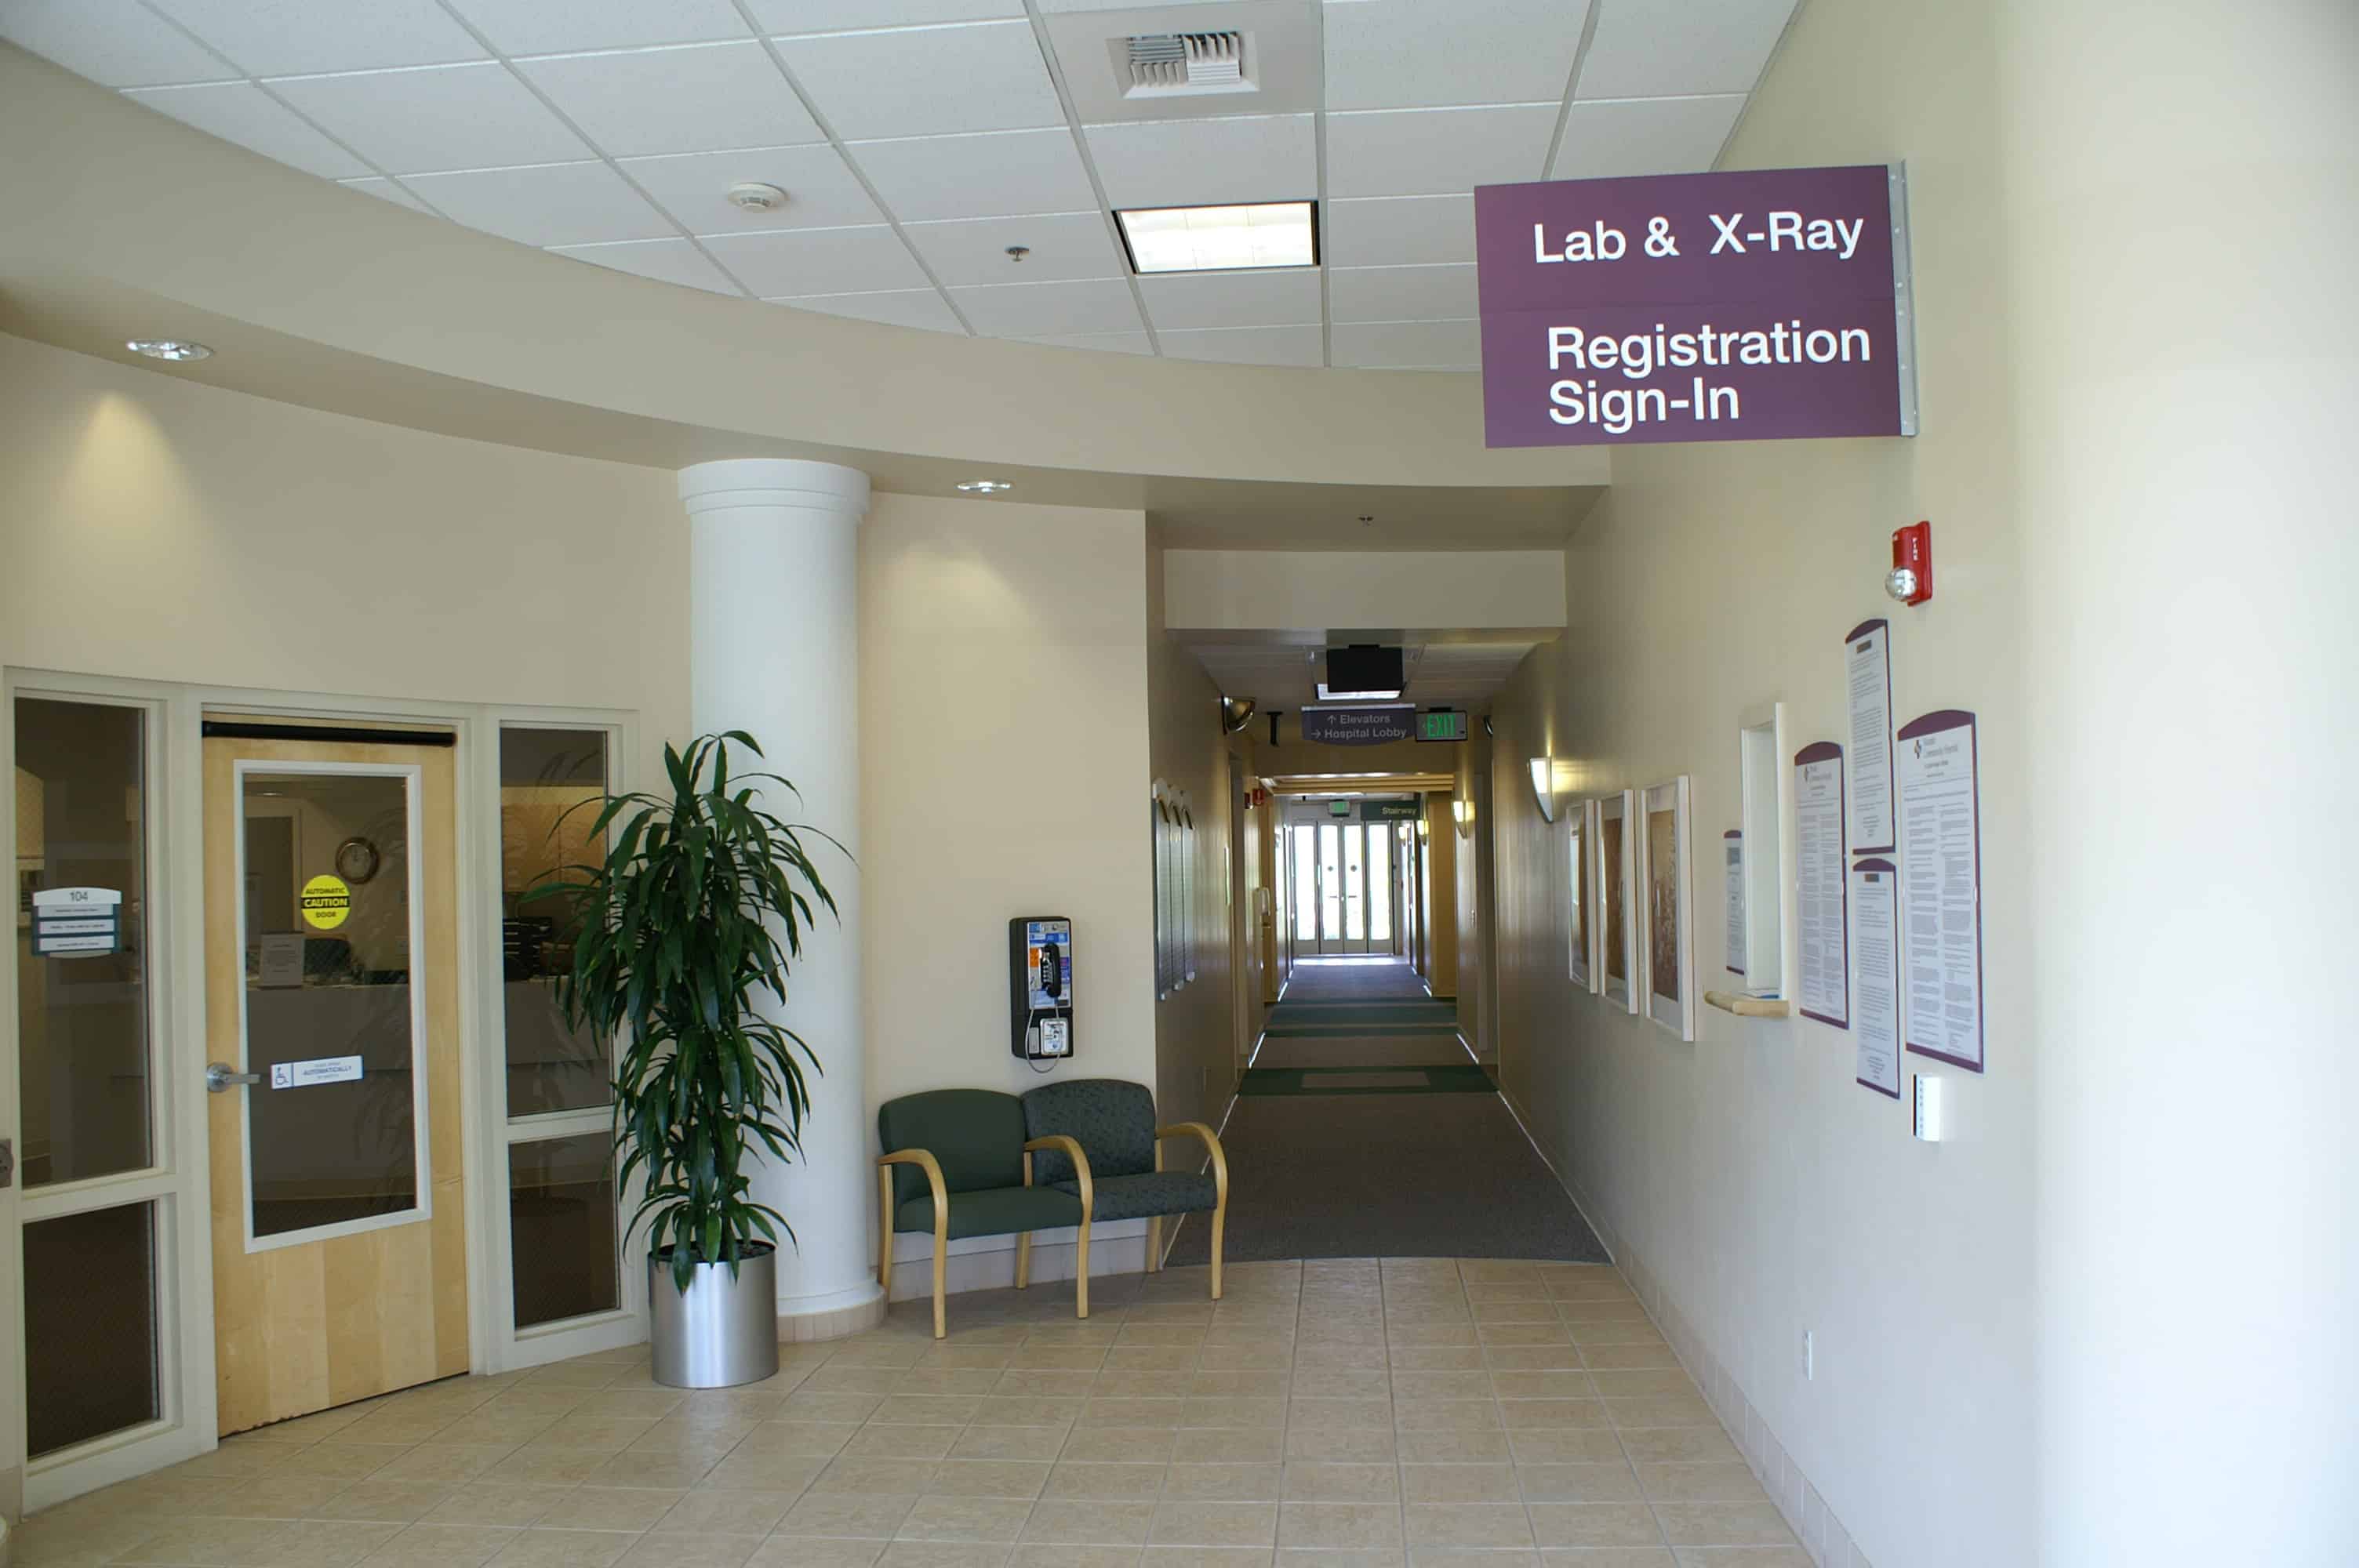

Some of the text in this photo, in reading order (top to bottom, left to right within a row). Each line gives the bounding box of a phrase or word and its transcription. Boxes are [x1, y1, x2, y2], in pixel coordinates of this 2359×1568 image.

[1534, 211, 1863, 263] Lab & X-Ray
[1548, 320, 1870, 379] Registration
[1549, 377, 1739, 434] Sign-In
[1339, 714, 1390, 724] Elevators
[1427, 714, 1456, 739] EXIT
[1324, 728, 1407, 740] Hospital Lobby
[1382, 806, 1418, 815] Stairway
[69, 891, 88, 902] 104
[304, 898, 348, 907] CAUTION
